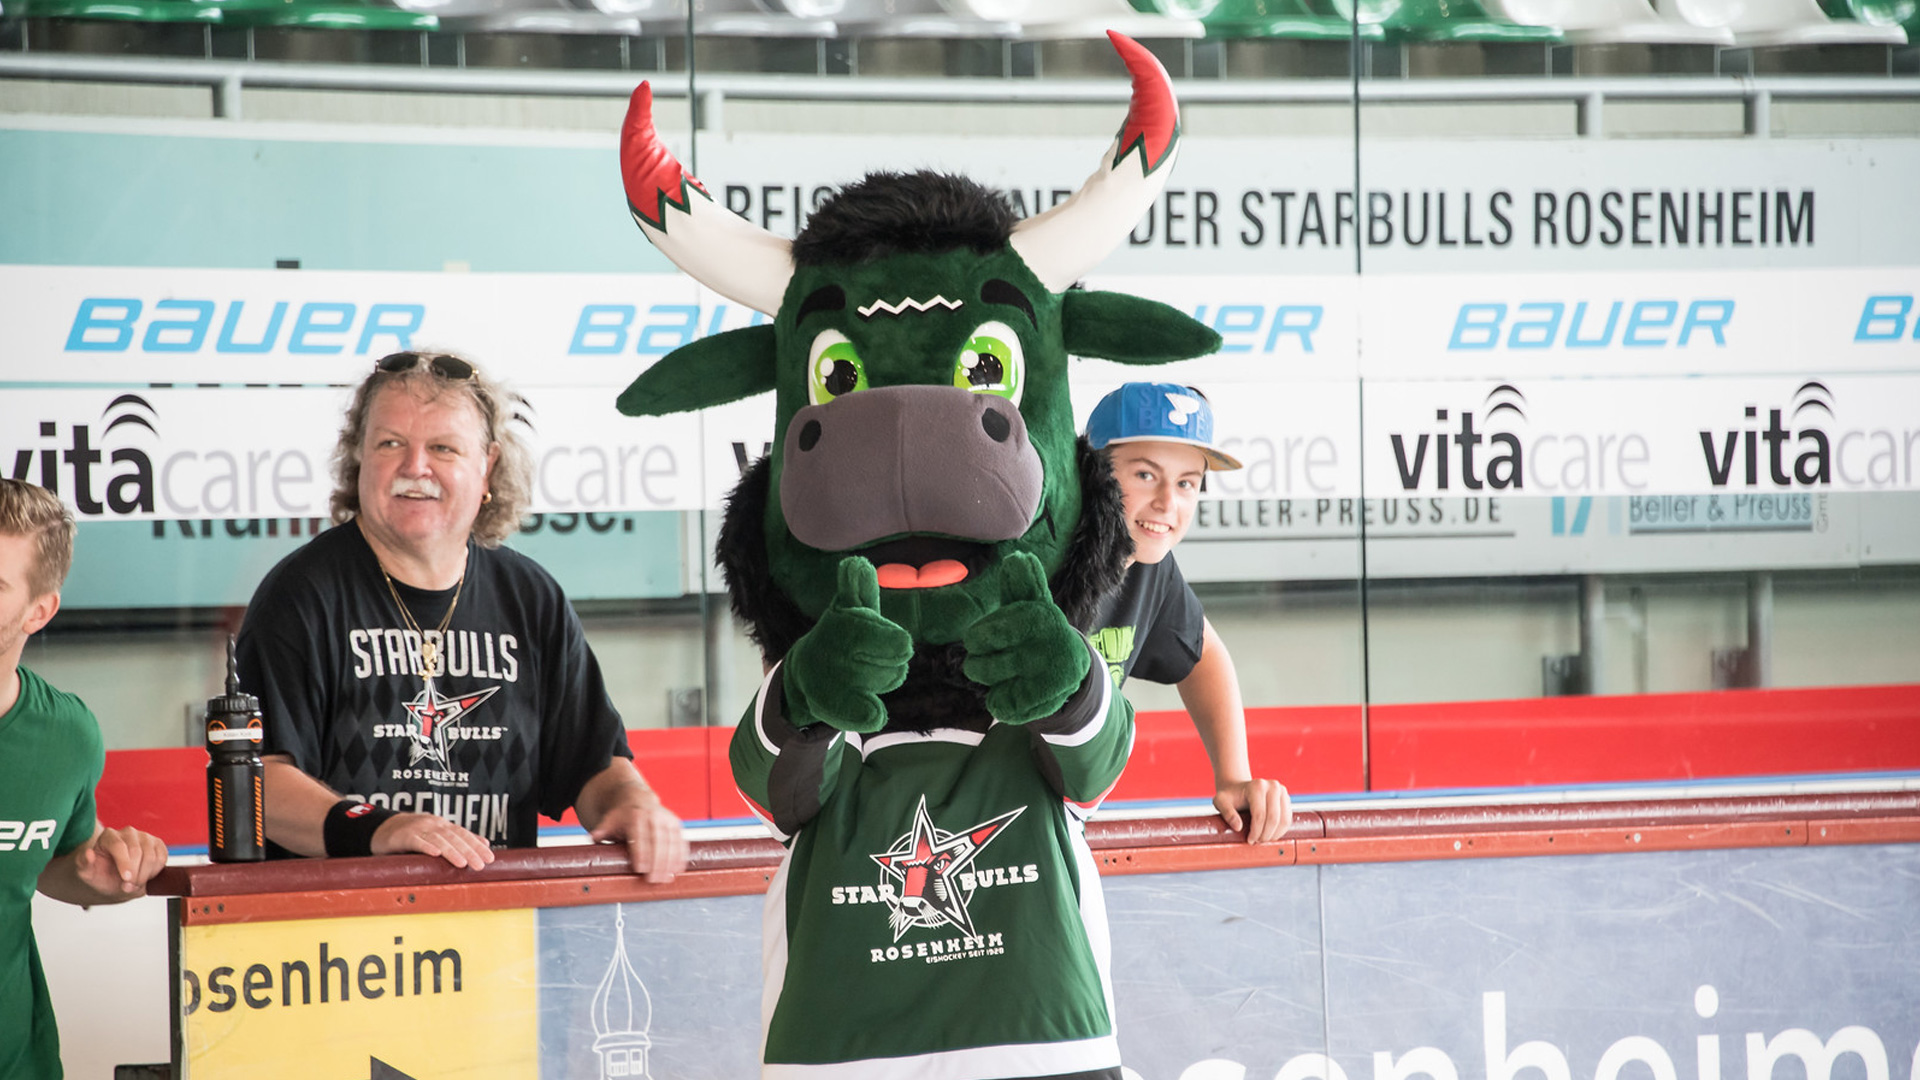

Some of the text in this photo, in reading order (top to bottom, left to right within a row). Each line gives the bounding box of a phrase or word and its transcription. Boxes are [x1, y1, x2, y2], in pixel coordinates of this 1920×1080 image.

[1129, 191, 1219, 246] DER
[1240, 190, 1516, 248] STARBULLS
[1533, 191, 1817, 247] ROSENHEIM
[8, 421, 313, 516] itacare
[1390, 409, 1651, 490] vitacare
[1699, 406, 1920, 487] vitacar
[350, 628, 518, 683] STARBULLS
[373, 724, 502, 740] STAR BULLS
[831, 864, 1039, 905] STAR BULLS
[870, 932, 1003, 963] ROSENHEIM
